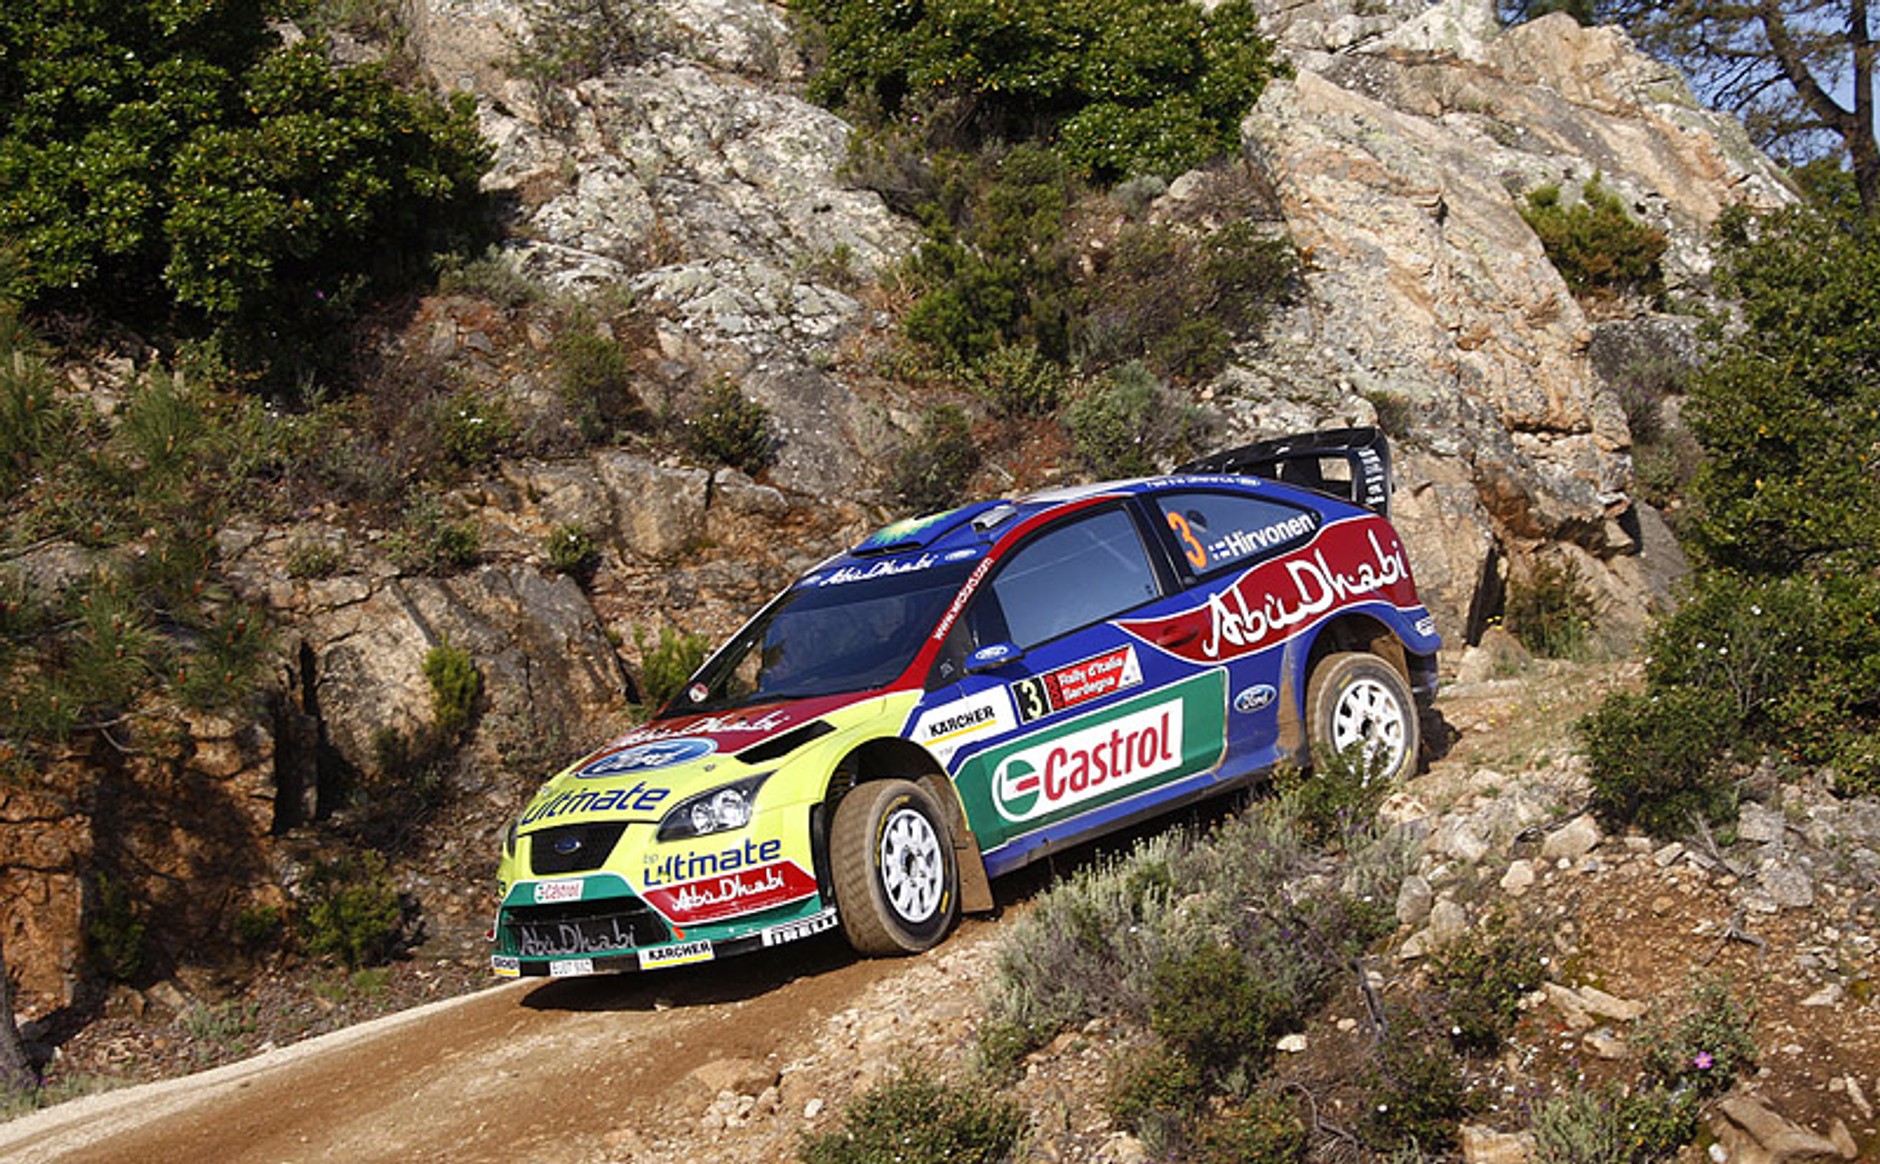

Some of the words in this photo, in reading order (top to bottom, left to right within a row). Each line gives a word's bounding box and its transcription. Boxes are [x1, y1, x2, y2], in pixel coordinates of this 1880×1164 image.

[1167, 511, 1207, 569] 3
[1226, 513, 1315, 556] Hirvonen
[1021, 680, 1043, 718] 3
[1044, 712, 1173, 801] Castrol
